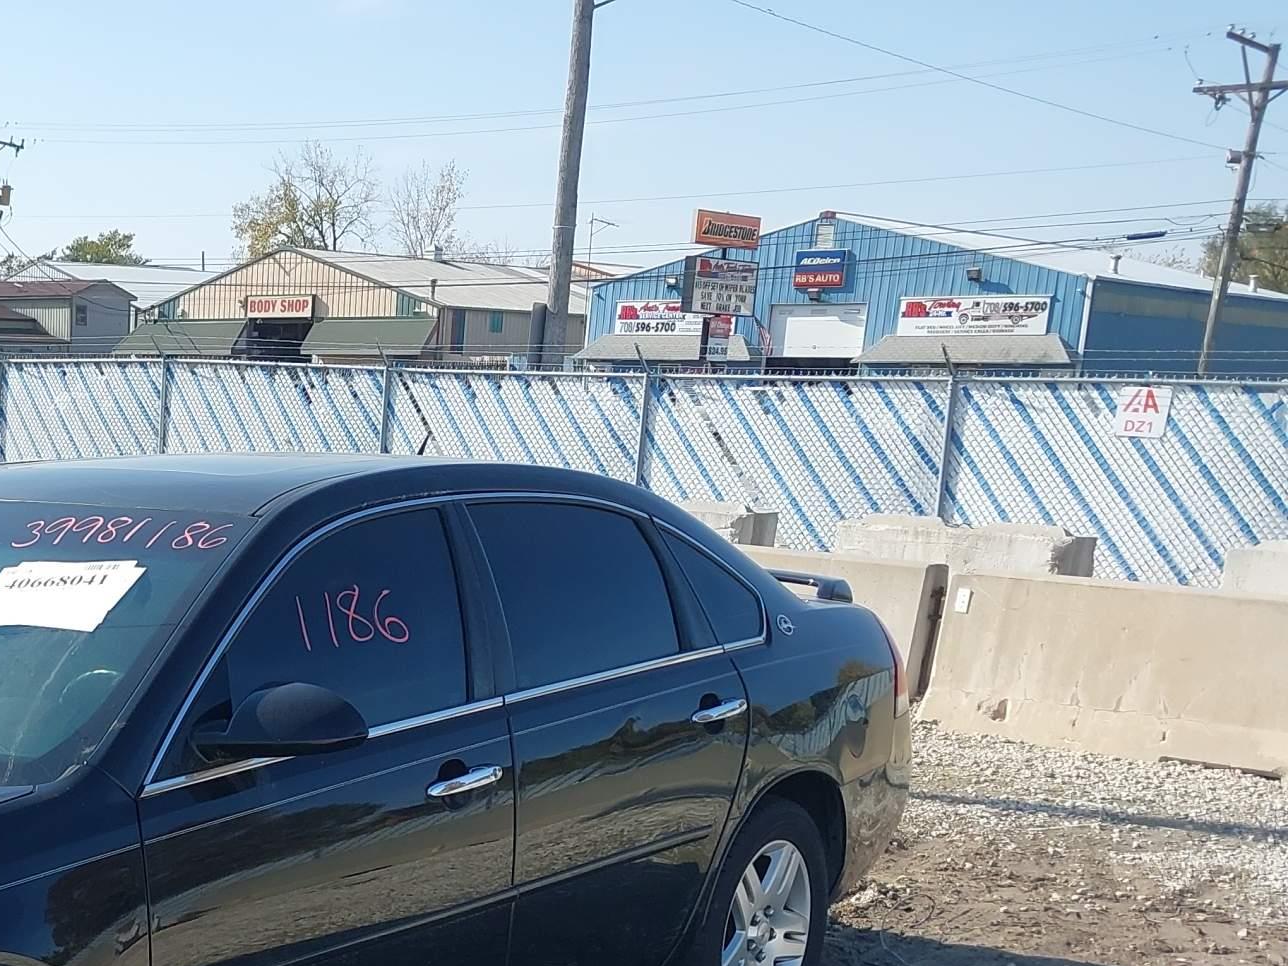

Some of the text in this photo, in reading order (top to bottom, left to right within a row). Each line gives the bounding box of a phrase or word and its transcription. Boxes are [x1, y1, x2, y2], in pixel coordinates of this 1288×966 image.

[702, 218, 758, 241] BRIDGESTONE
[799, 256, 841, 266] ACDelco
[795, 273, 840, 283] RB'S AUTO
[249, 299, 309, 313] BODY SHOP
[984, 301, 1048, 313] 708/596-5700
[619, 321, 676, 333] 708/596-5700
[1123, 420, 1153, 433] DZ1
[11, 516, 233, 550] 39981186
[4, 574, 110, 590] 40668041
[295, 584, 410, 652] 1186
